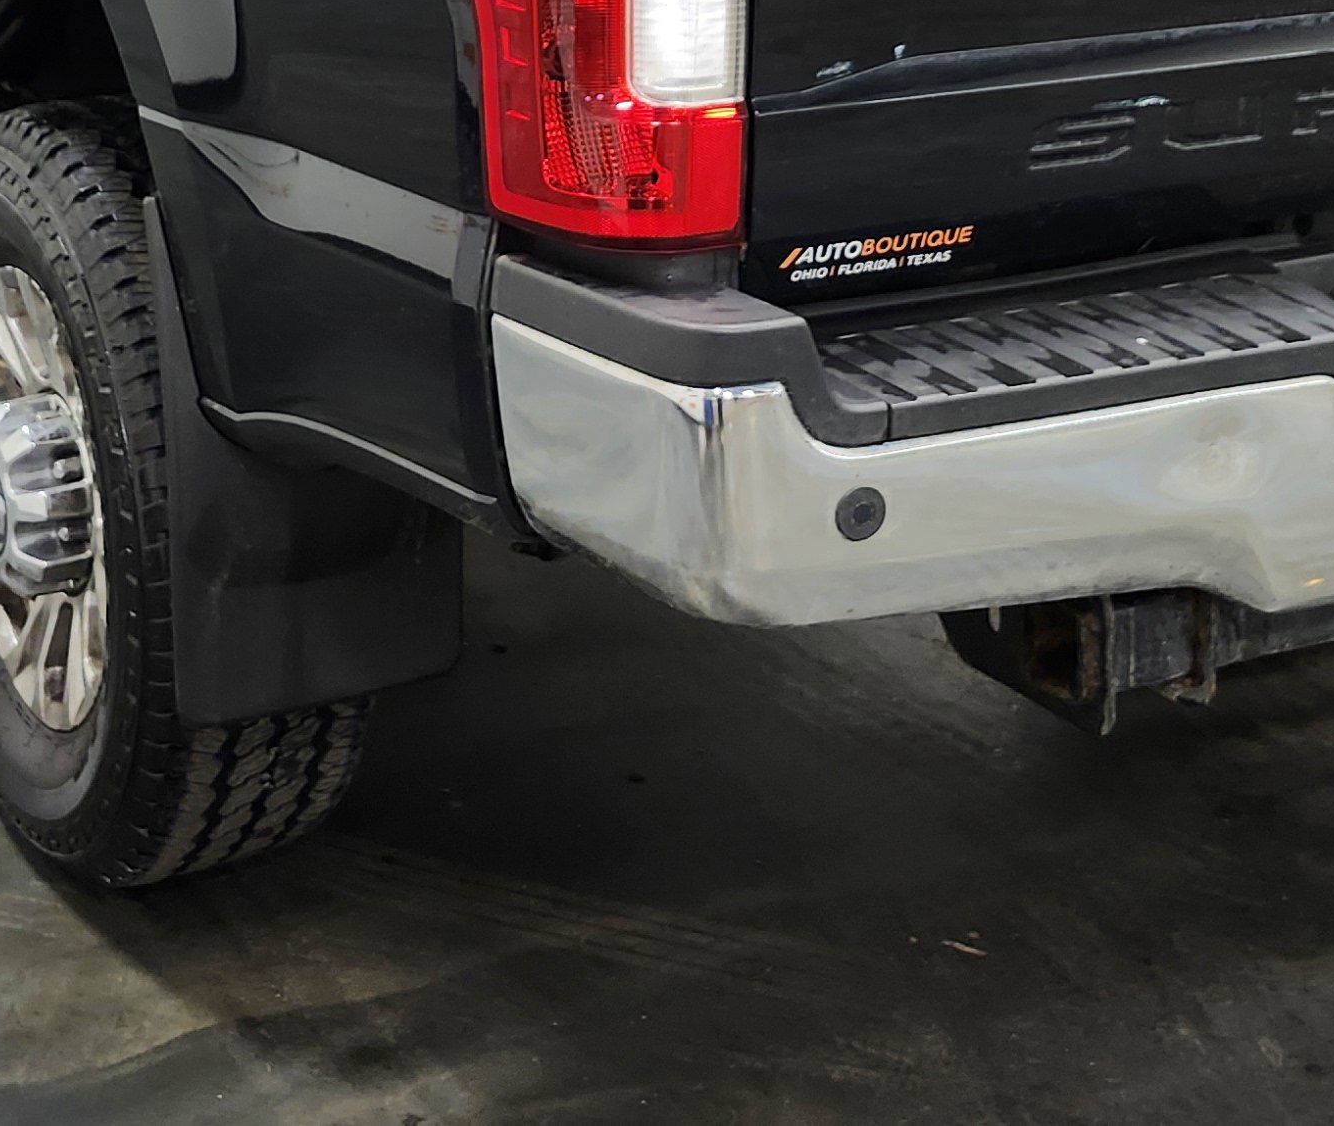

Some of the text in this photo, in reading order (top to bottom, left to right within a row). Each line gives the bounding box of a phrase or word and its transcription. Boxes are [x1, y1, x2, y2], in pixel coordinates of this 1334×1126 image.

[794, 225, 974, 265] AUTOBOUTIQUE
[790, 250, 952, 282] OHIO FLORIDA TEXAS
